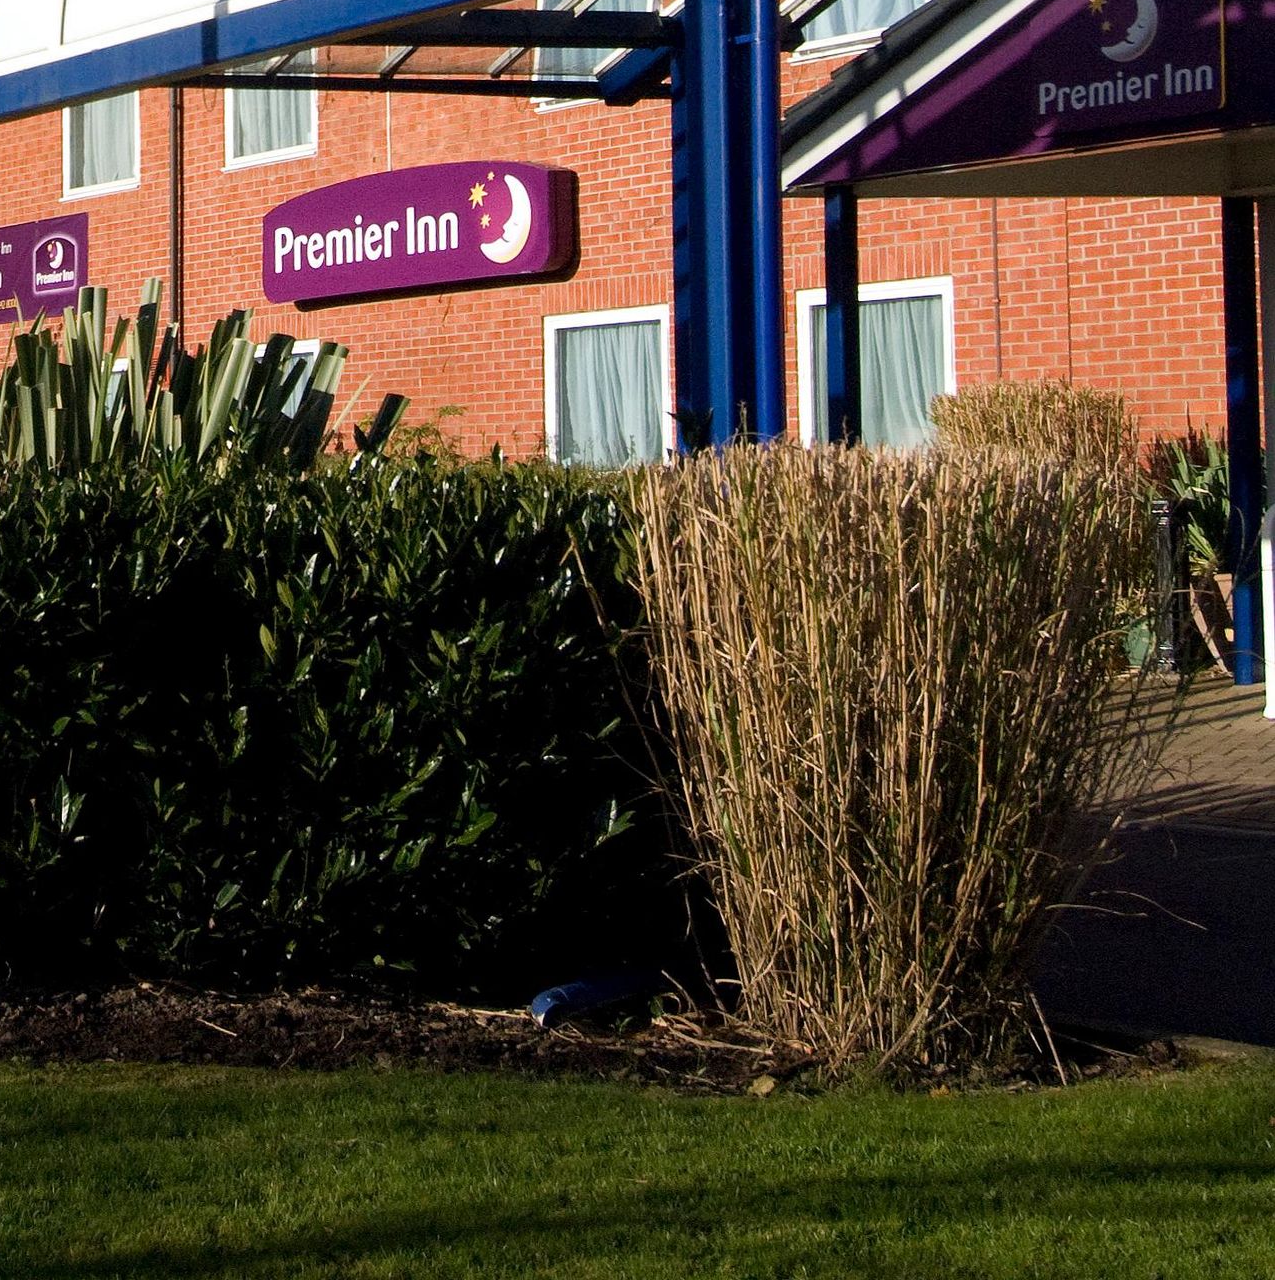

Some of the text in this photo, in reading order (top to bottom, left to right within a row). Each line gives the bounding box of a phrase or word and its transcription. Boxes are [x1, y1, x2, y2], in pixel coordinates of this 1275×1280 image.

[1038, 63, 1214, 115] Premier Inn
[1, 242, 13, 255] Inn
[274, 206, 459, 274] Premier Inn
[36, 269, 75, 286] Premier Inn
